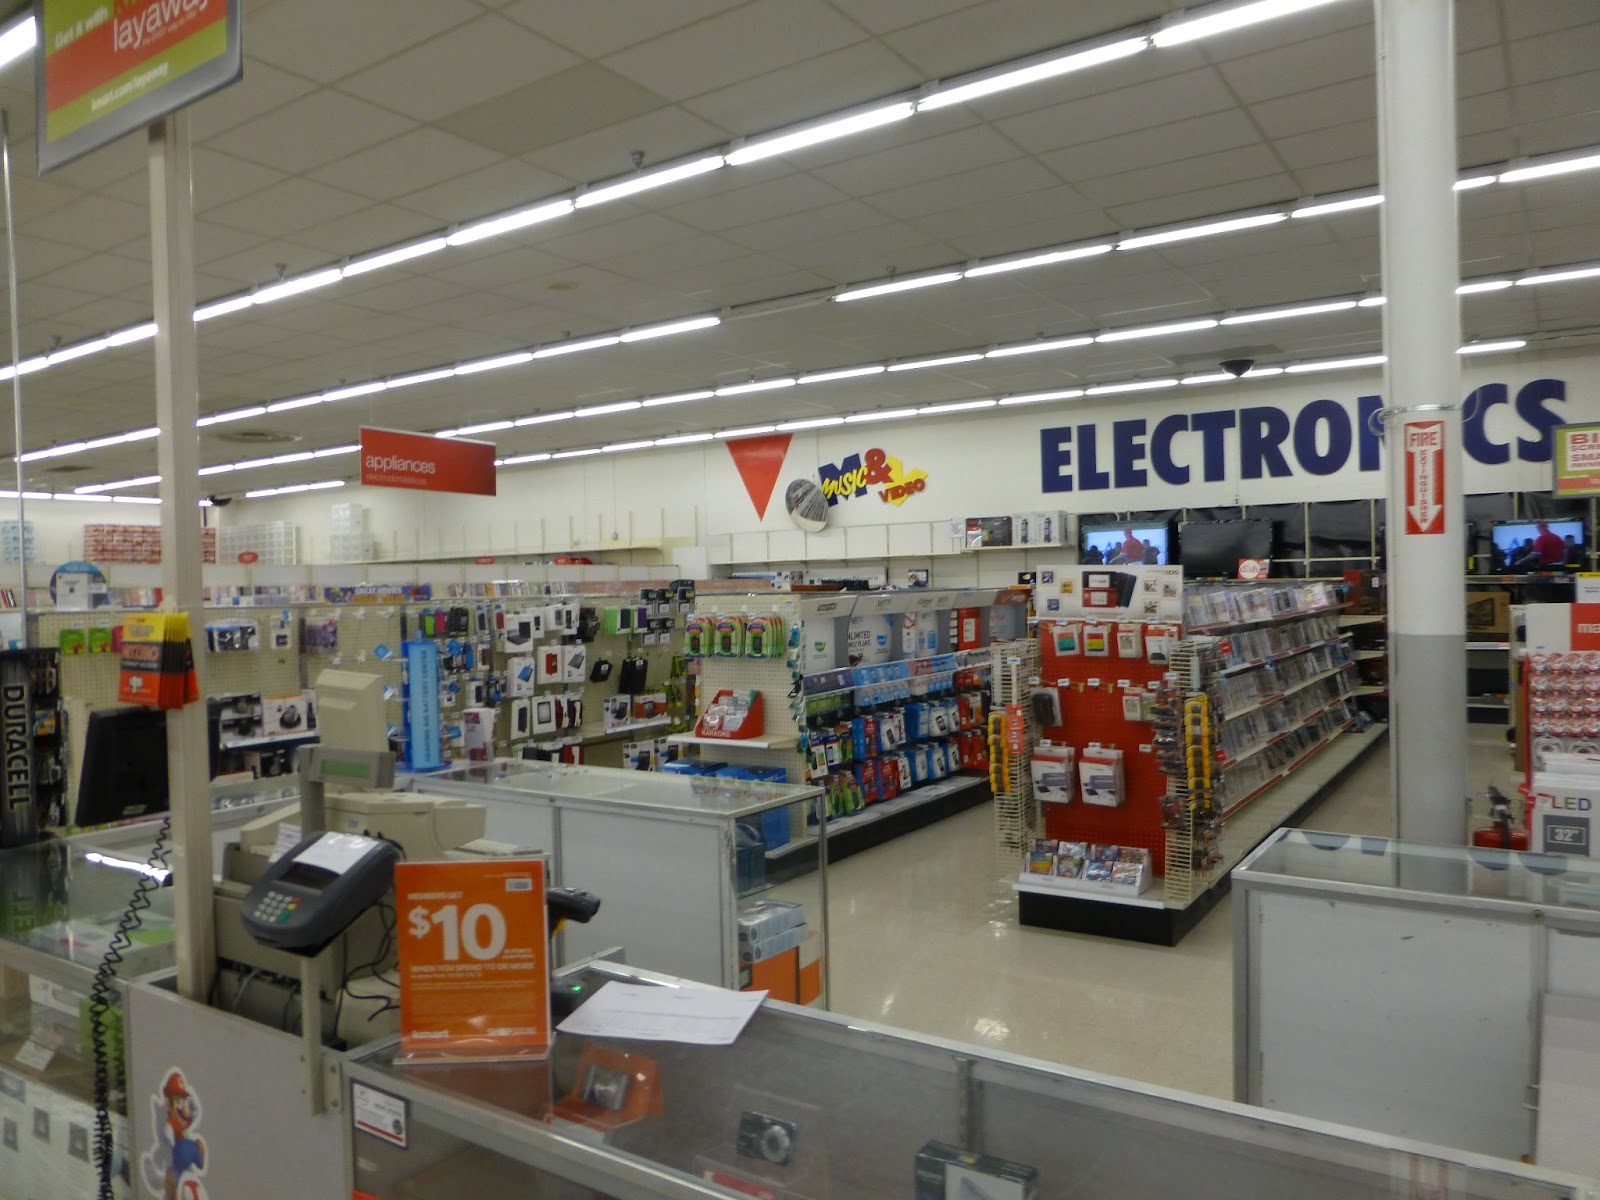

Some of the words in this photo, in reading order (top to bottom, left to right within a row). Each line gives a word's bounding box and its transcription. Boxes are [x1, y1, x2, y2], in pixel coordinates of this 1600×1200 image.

[1040, 379, 1566, 493] ELECTROCS
[1410, 431, 1438, 447] FIRE
[365, 454, 436, 475] appliances
[878, 478, 926, 503] VIDEO
[1418, 449, 1429, 524] EXTINGUISHER
[1240, 564, 1258, 574] dish
[701, 729, 731, 738] KARAOKE
[2, 684, 31, 811] DURACELL
[1552, 796, 1592, 811] LED
[408, 903, 507, 961] $10
